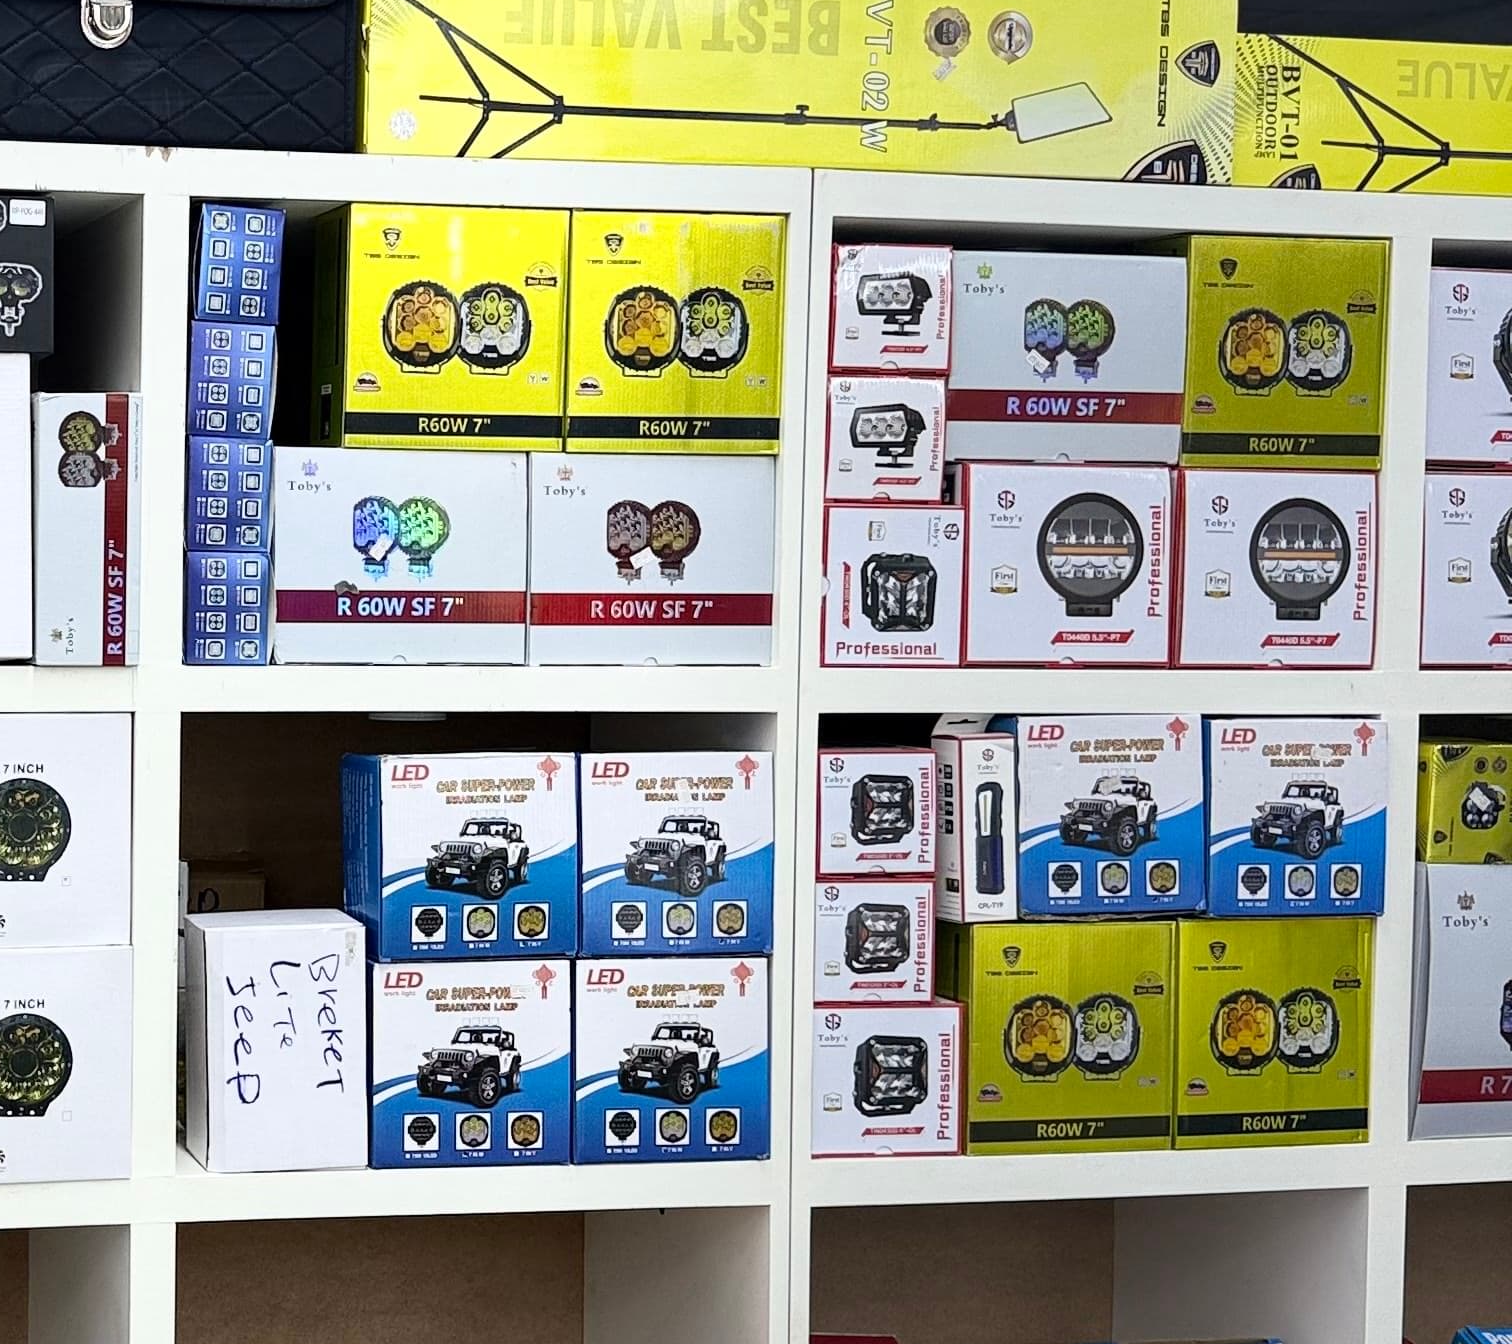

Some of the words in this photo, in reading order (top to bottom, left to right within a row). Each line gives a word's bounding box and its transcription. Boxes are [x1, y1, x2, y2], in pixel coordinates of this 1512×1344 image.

[1157, 45, 1169, 128] DESIGN
[1265, 63, 1279, 149] OUTDOOR
[1279, 64, 1302, 162] BVT-01
[860, 120, 888, 153] W
[963, 282, 1006, 296] Toby's
[1445, 305, 1477, 316] Toby's
[1006, 398, 1021, 416] R
[1026, 398, 1072, 416] 60W
[1077, 398, 1100, 416] SF
[1105, 398, 1127, 416] 7"
[417, 417, 467, 433] R60W
[472, 417, 492, 432] 7"
[639, 421, 687, 436] R60W
[692, 420, 711, 435] 7"
[1249, 437, 1294, 452] R60W
[1298, 437, 1316, 452] 7"
[287, 478, 333, 493] Toby's
[543, 483, 587, 498] Toby's
[989, 513, 1024, 525] Toby's
[1205, 518, 1236, 529] Toby's
[1147, 505, 1163, 618] Professional
[1353, 510, 1368, 622] Professional
[994, 571, 1014, 581] First
[1209, 576, 1228, 585] First
[107, 594, 124, 635] 60W
[336, 597, 352, 617] R
[357, 597, 406, 617] 60W
[411, 597, 435, 617] SF
[440, 597, 465, 618] 7"
[590, 600, 605, 619] R
[610, 600, 658, 619] 60W
[663, 601, 686, 619] SF
[691, 601, 713, 620] 7"
[107, 641, 123, 656] R
[836, 641, 937, 659] Professional
[1027, 724, 1065, 742] LED
[1221, 728, 1257, 745] LED
[3, 763, 11, 774] 7
[15, 763, 45, 774] INCH
[391, 764, 430, 782] LED
[591, 761, 630, 779] LED
[461, 778, 536, 793] SUPER-POWER
[918, 767, 931, 864] Professional
[1442, 915, 1489, 928] Toby's
[913, 895, 927, 993] Professional
[384, 971, 424, 989] LED
[586, 968, 625, 985] LED
[4, 999, 11, 1010] 7
[16, 998, 46, 1009] INCH
[818, 1033, 849, 1043] Toby's
[937, 1032, 952, 1141] Professional
[1480, 1076, 1495, 1095] R
[1036, 1122, 1083, 1138] R60W
[1087, 1121, 1105, 1137] 7"
[1242, 1115, 1287, 1131] R60W
[1291, 1113, 1307, 1130] 7"
